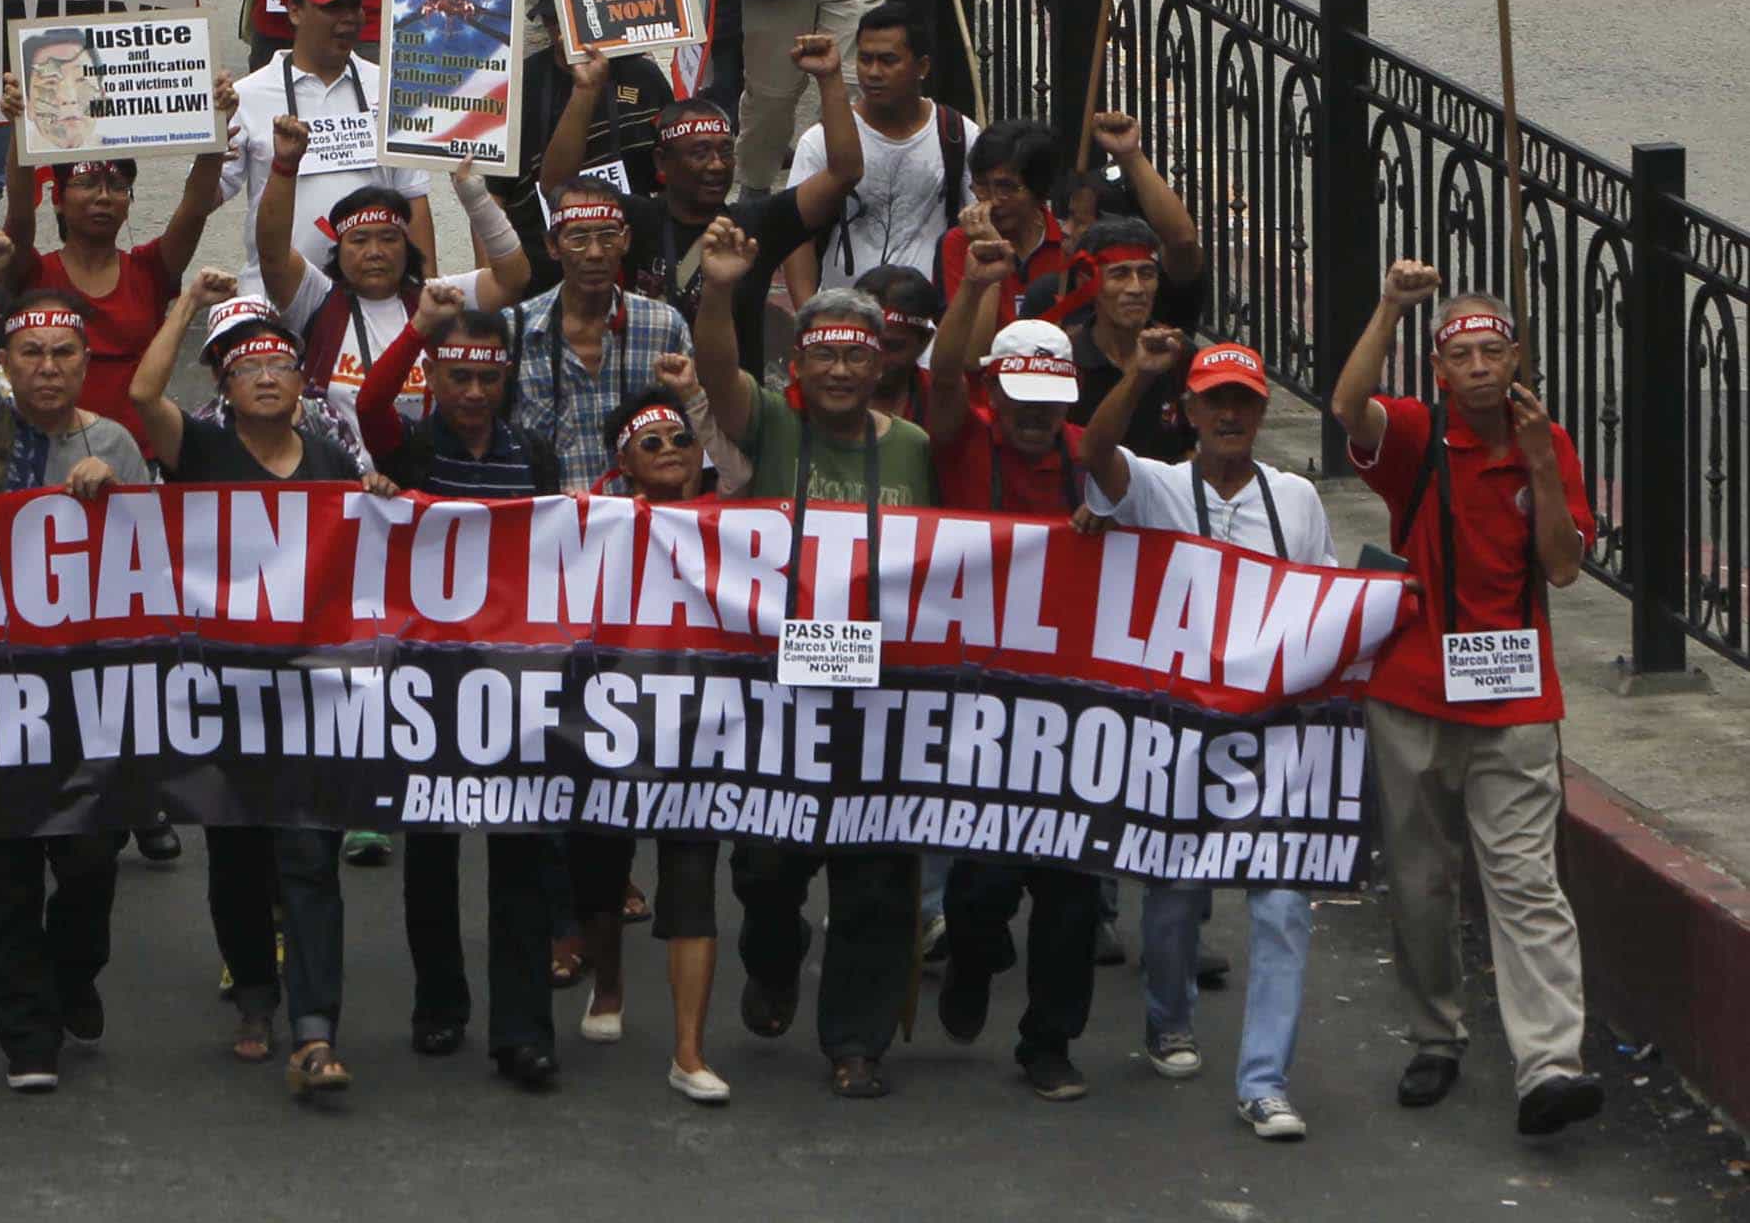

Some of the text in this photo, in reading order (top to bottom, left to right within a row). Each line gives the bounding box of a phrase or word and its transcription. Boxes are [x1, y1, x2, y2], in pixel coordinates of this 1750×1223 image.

[609, 0, 667, 21] NOW!
[84, 24, 192, 49] Justice
[128, 48, 150, 61] and
[83, 59, 206, 77] Indemnification
[104, 76, 193, 93] to all victims of
[90, 93, 208, 118] MARTIAL LAW!
[340, 117, 368, 130] the
[392, 114, 434, 133] Now!
[661, 119, 719, 140] TULOY ANG
[333, 131, 372, 142] Victims
[320, 151, 354, 161] NOW!
[359, 210, 387, 224] ANG
[28, 312, 44, 326] TO
[823, 328, 852, 342] AGAIN
[249, 340, 272, 355] FOR
[469, 348, 491, 360] ANG
[1000, 356, 1025, 372] END
[343, 492, 491, 623] TO
[526, 494, 1058, 655] MARTIAL
[1092, 531, 1403, 694] LAW!
[785, 623, 872, 640] PASS the
[784, 639, 874, 653] Marcos Victims
[1448, 635, 1530, 653] PASS the
[784, 652, 855, 664] Compensation
[1449, 652, 1533, 666] Marcos Victims
[809, 663, 848, 673] NOW!
[1474, 675, 1512, 686] NOW!
[72, 662, 437, 763] VICTIMS
[456, 668, 563, 767] OF
[584, 671, 834, 782] STATE
[853, 688, 1366, 821] TERRORISM!
[401, 775, 1361, 882] BAGONG ALYANSANG MAKABAYAN KARAPATAN
